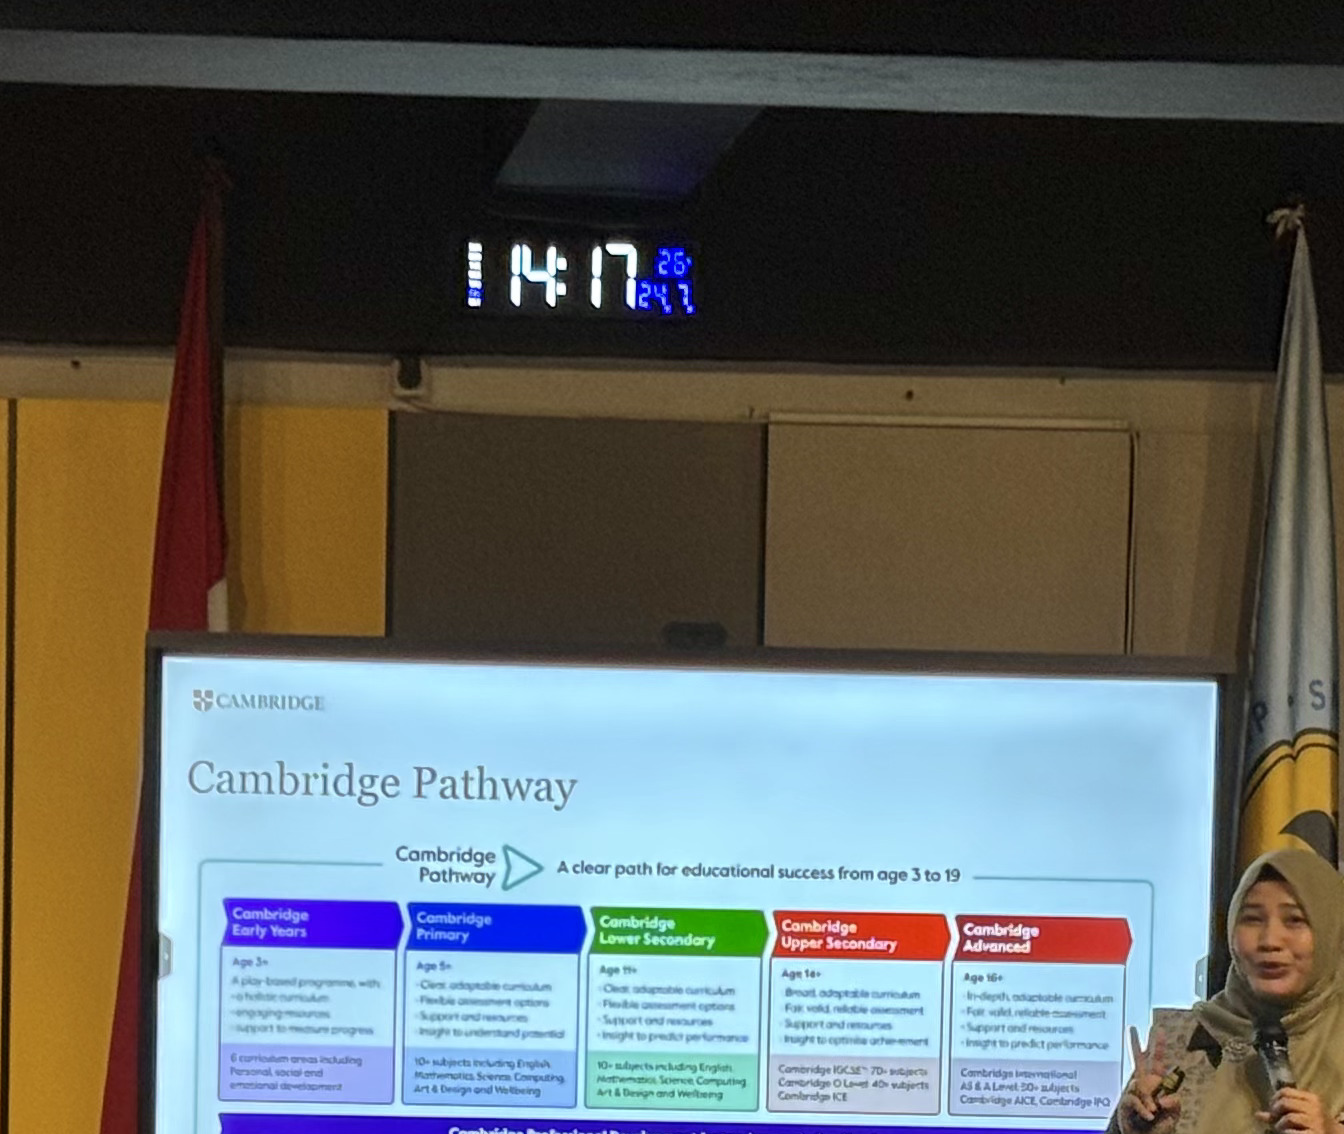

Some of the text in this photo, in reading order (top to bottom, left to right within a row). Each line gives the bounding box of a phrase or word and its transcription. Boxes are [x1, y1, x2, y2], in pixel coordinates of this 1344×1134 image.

[510, 243, 637, 309] 14:17
[216, 693, 325, 711] CAMBRIDGE
[188, 760, 578, 811] Cambridge Pathway
[395, 846, 496, 867] Cambridge
[419, 868, 496, 888] Pathway
[557, 861, 960, 885] A clear path for educational success from age 3 to 19
[232, 908, 309, 923] Cambridge
[417, 913, 492, 927] Cambridge
[599, 916, 675, 931] Cambridge
[782, 920, 858, 935] Cambridge
[964, 923, 1040, 938] Cambridge
[232, 925, 307, 940] Early Years
[416, 929, 470, 944] Primary
[599, 933, 715, 948] Lower Secondary
[782, 937, 897, 952] Upper Secondary
[964, 940, 1031, 953] Advanced
[233, 957, 268, 968] Age 3+
[416, 962, 451, 973] Age 5+
[600, 966, 620, 976] Age
[782, 970, 802, 980] Age
[964, 973, 1003, 984] Age 16+
[603, 1031, 749, 1043] Insight to predict performance
[960, 1068, 1077, 1080] Cambridge International
[280, 1082, 342, 1091] development
[414, 1085, 541, 1097] Art & Design and Wellbeing
[778, 1091, 847, 1102] Cambridge ICE
[960, 1095, 1092, 1109] Cambridge Cambridge
